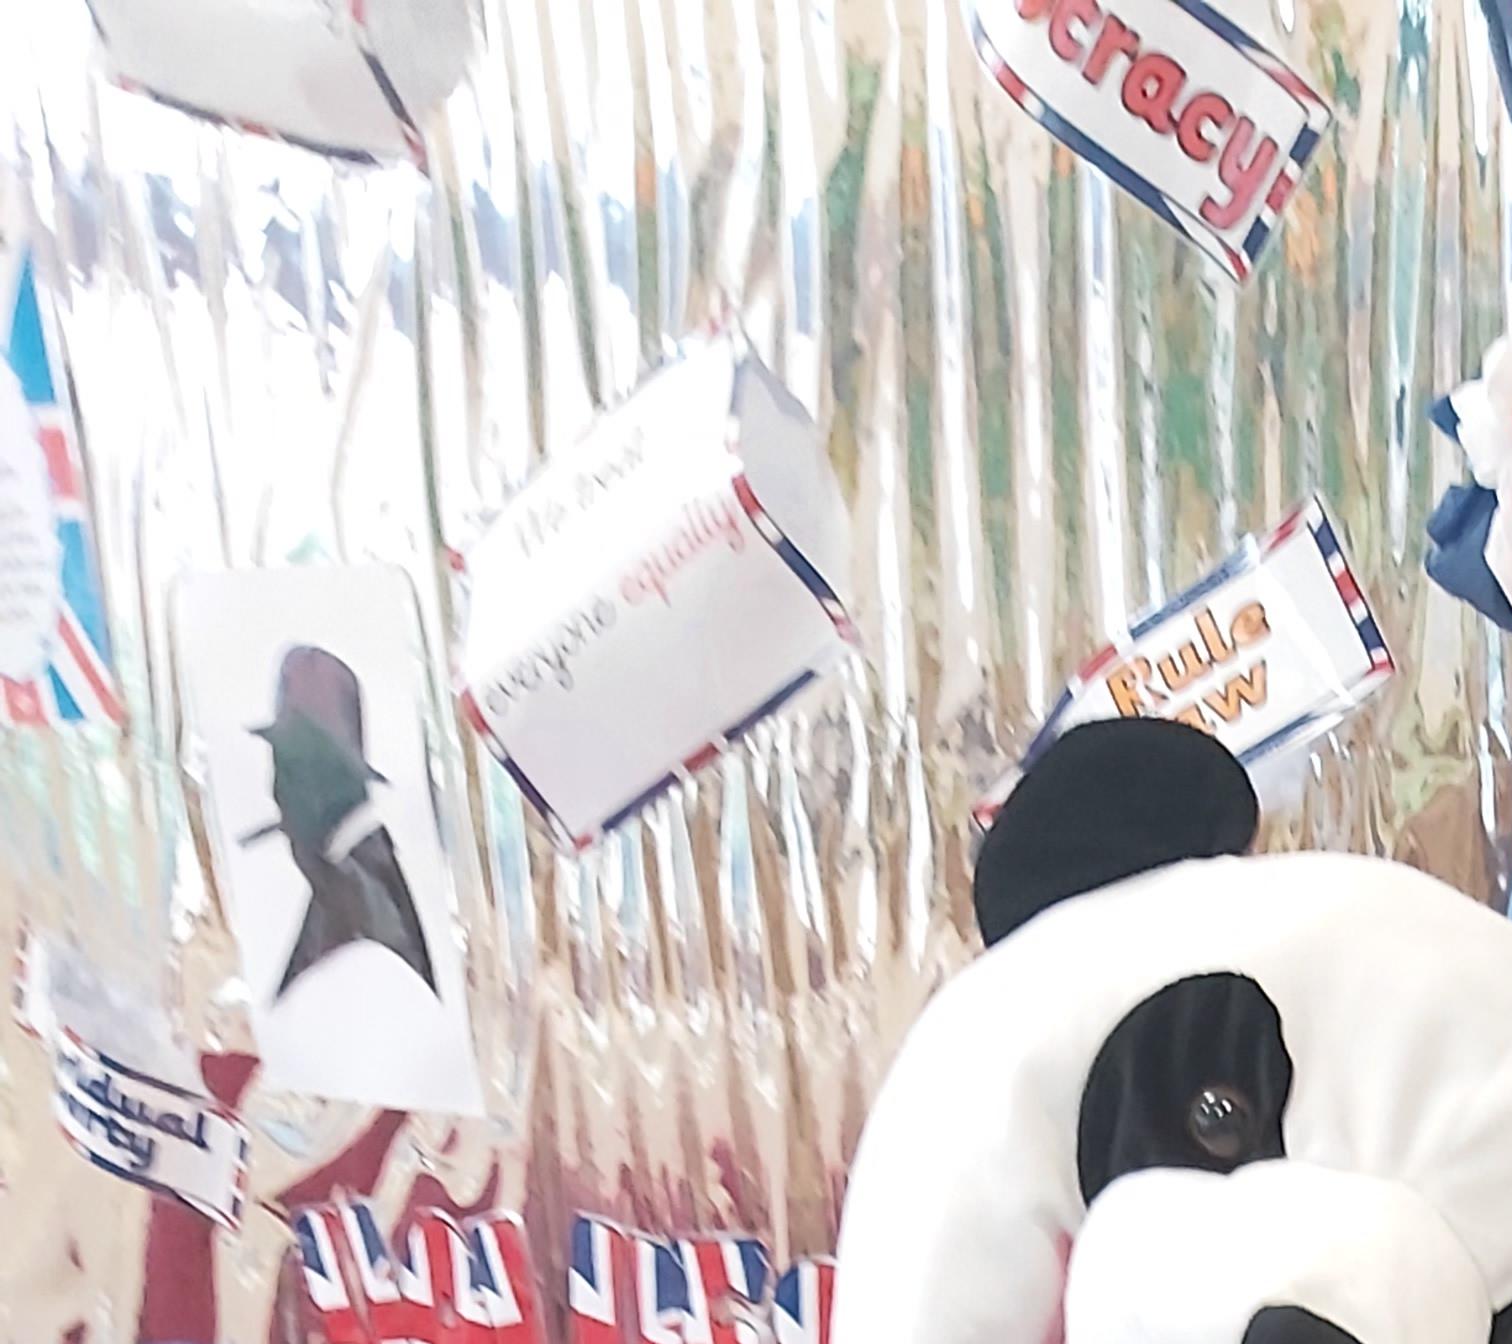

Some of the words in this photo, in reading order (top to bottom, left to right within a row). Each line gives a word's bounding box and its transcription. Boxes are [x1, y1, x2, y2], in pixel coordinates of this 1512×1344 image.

[1014, 0, 1279, 231] cracy
[1106, 599, 1272, 719] Rule
[1174, 658, 1268, 736] aw
